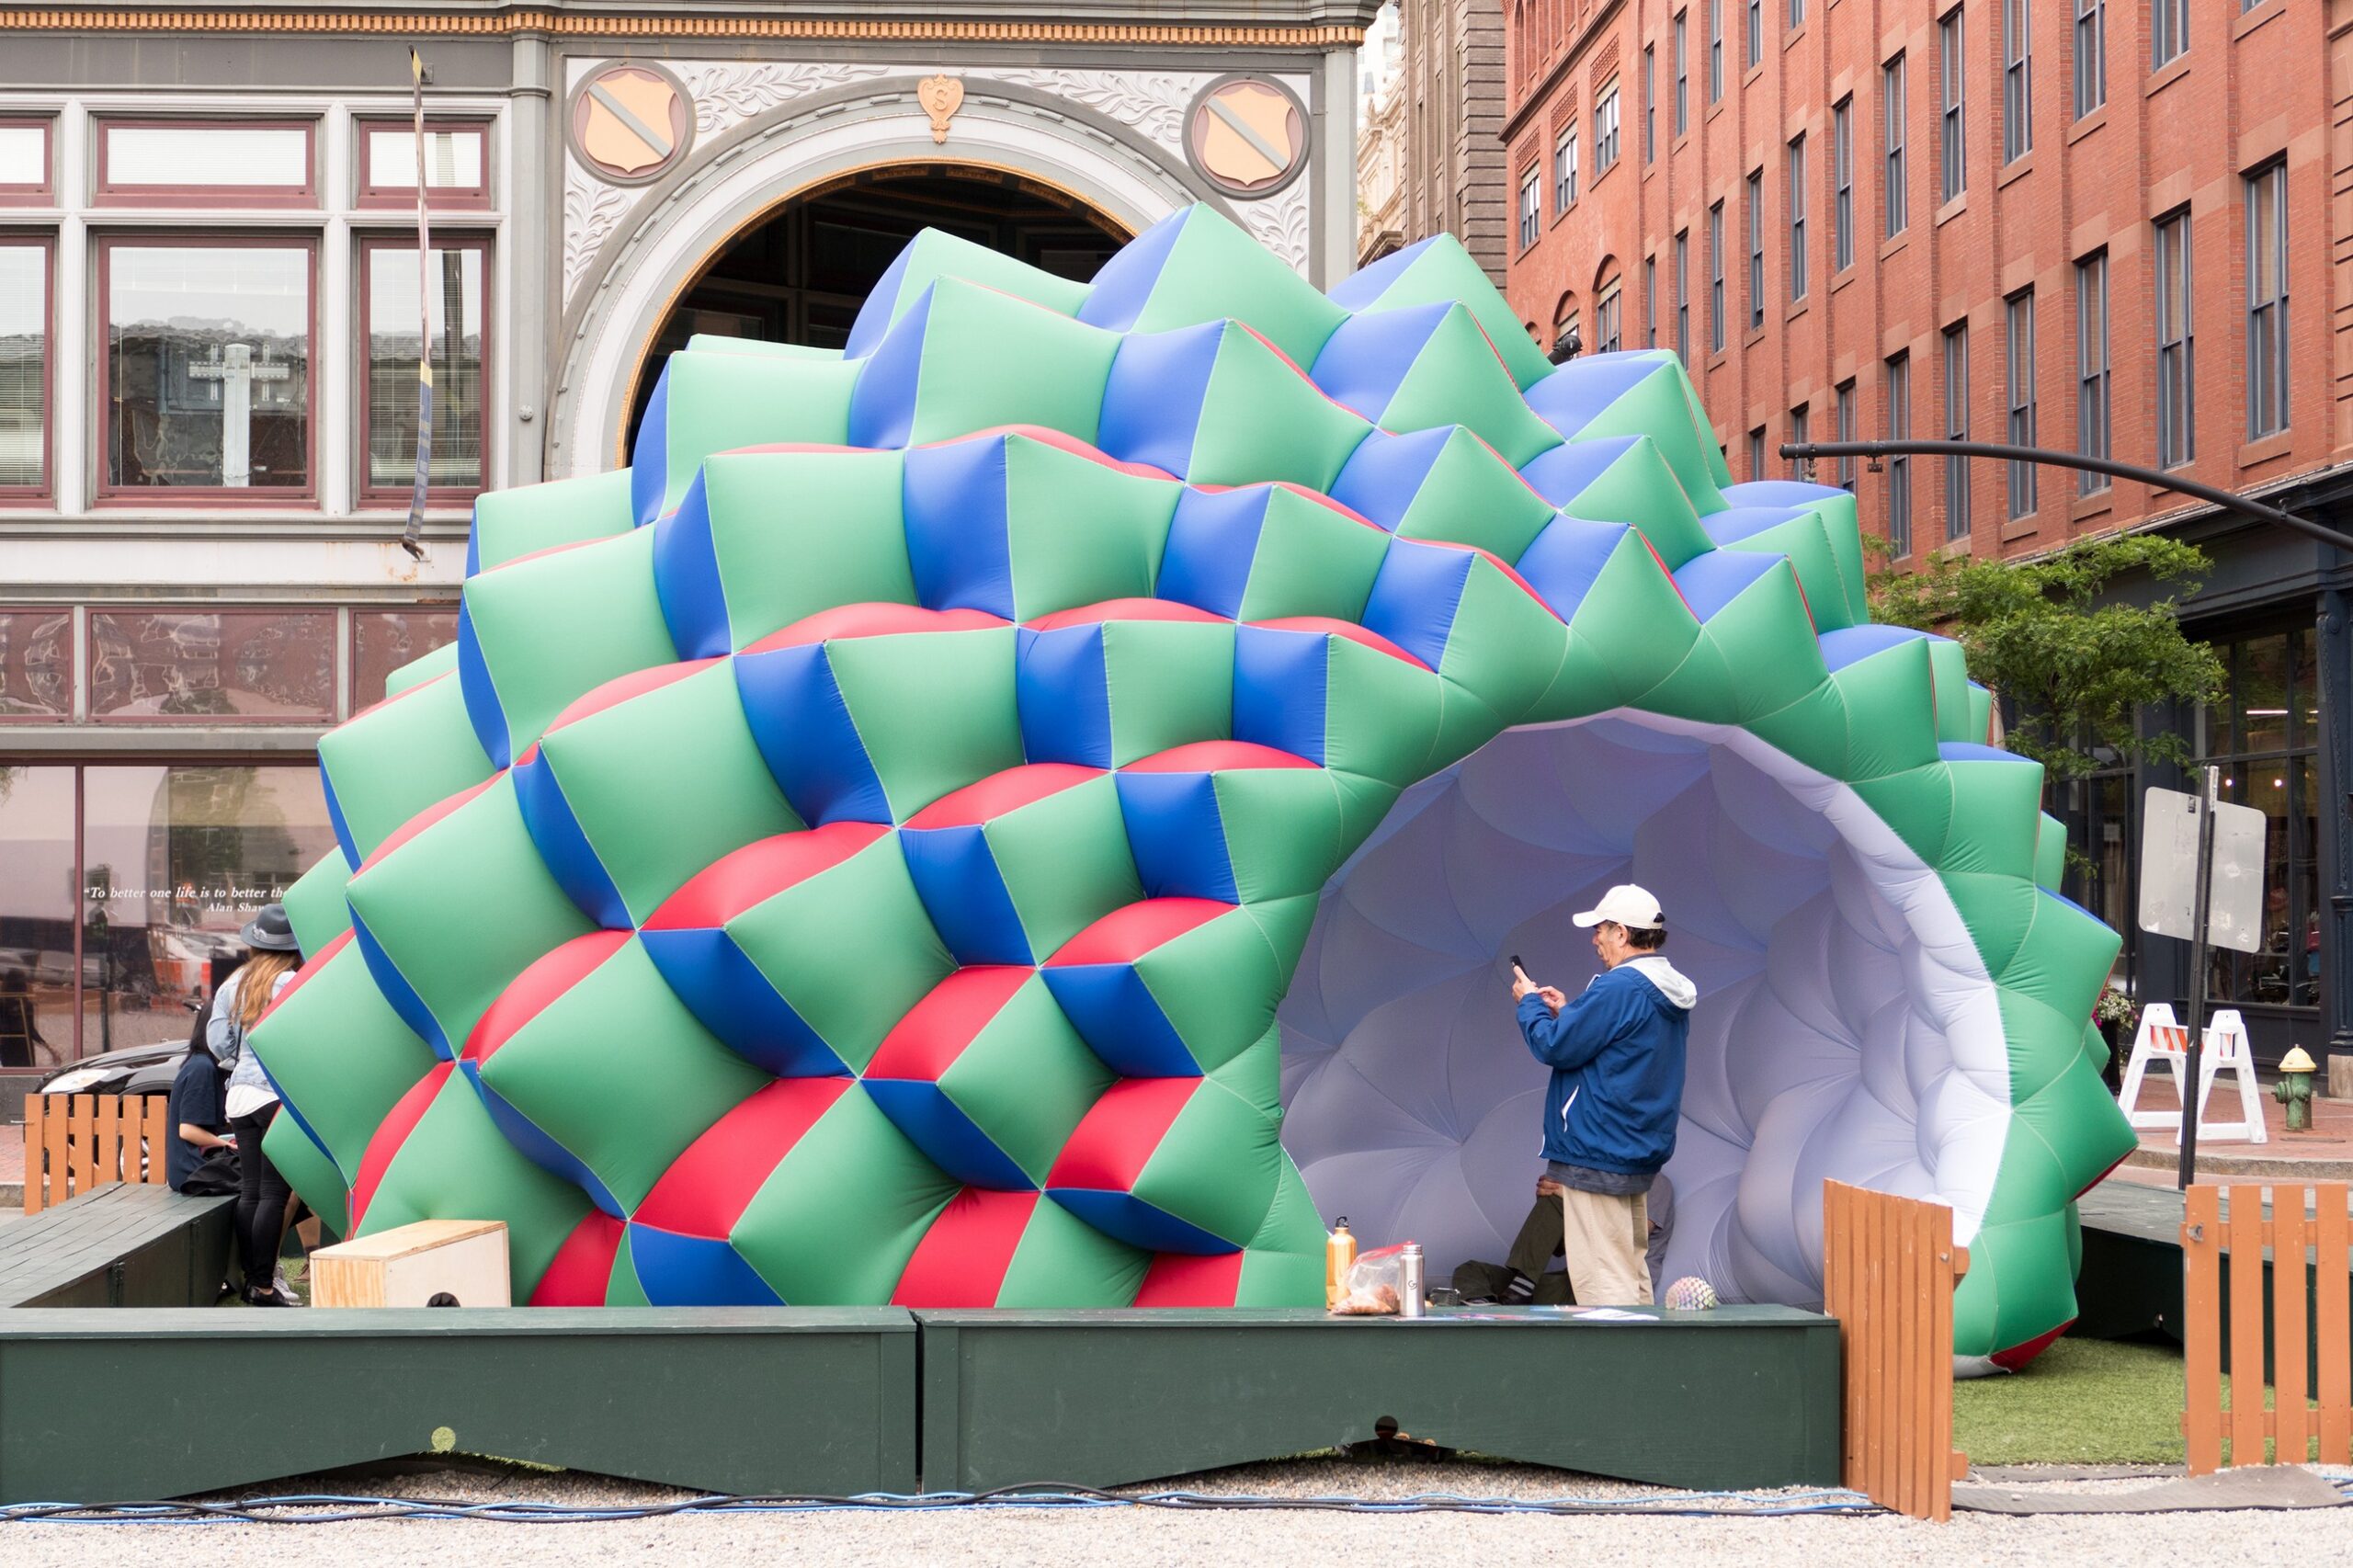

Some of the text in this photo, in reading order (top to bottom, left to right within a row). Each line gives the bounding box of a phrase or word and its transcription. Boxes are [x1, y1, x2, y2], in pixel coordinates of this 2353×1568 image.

[110, 886, 146, 898] better
[150, 889, 172, 898] one
[176, 886, 197, 899] life
[200, 886, 210, 898] is
[214, 888, 226, 898] to
[232, 886, 267, 898] better
[270, 886, 283, 898] th
[206, 903, 233, 913] Alan
